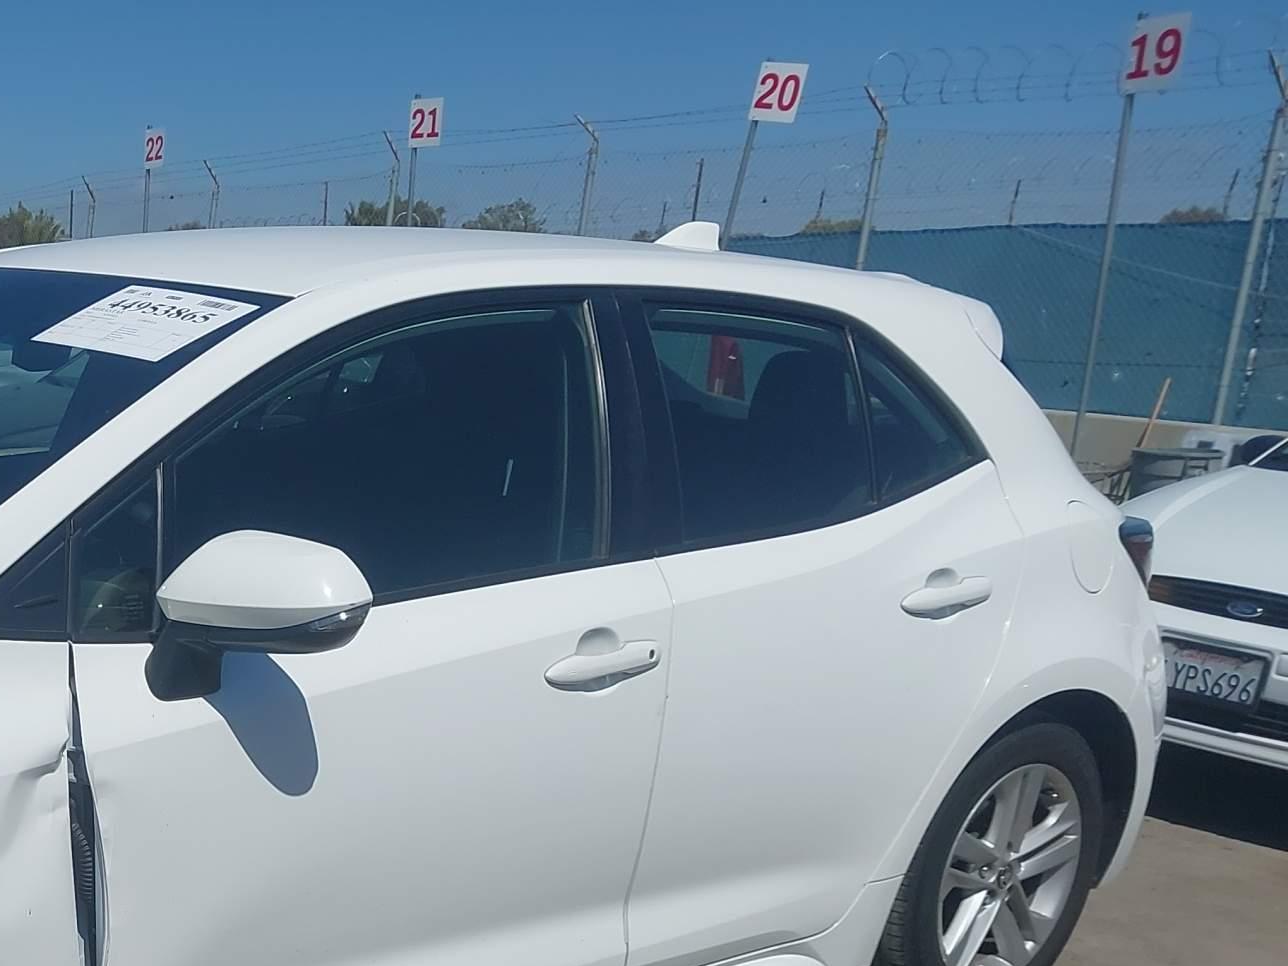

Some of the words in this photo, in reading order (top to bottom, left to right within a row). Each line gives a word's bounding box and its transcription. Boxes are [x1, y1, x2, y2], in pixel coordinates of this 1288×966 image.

[1126, 28, 1181, 80] 19
[754, 72, 800, 111] 20
[411, 107, 439, 138] 21
[146, 136, 164, 161] 22
[108, 298, 218, 324] 44953865
[1164, 660, 1257, 703] YPS696
